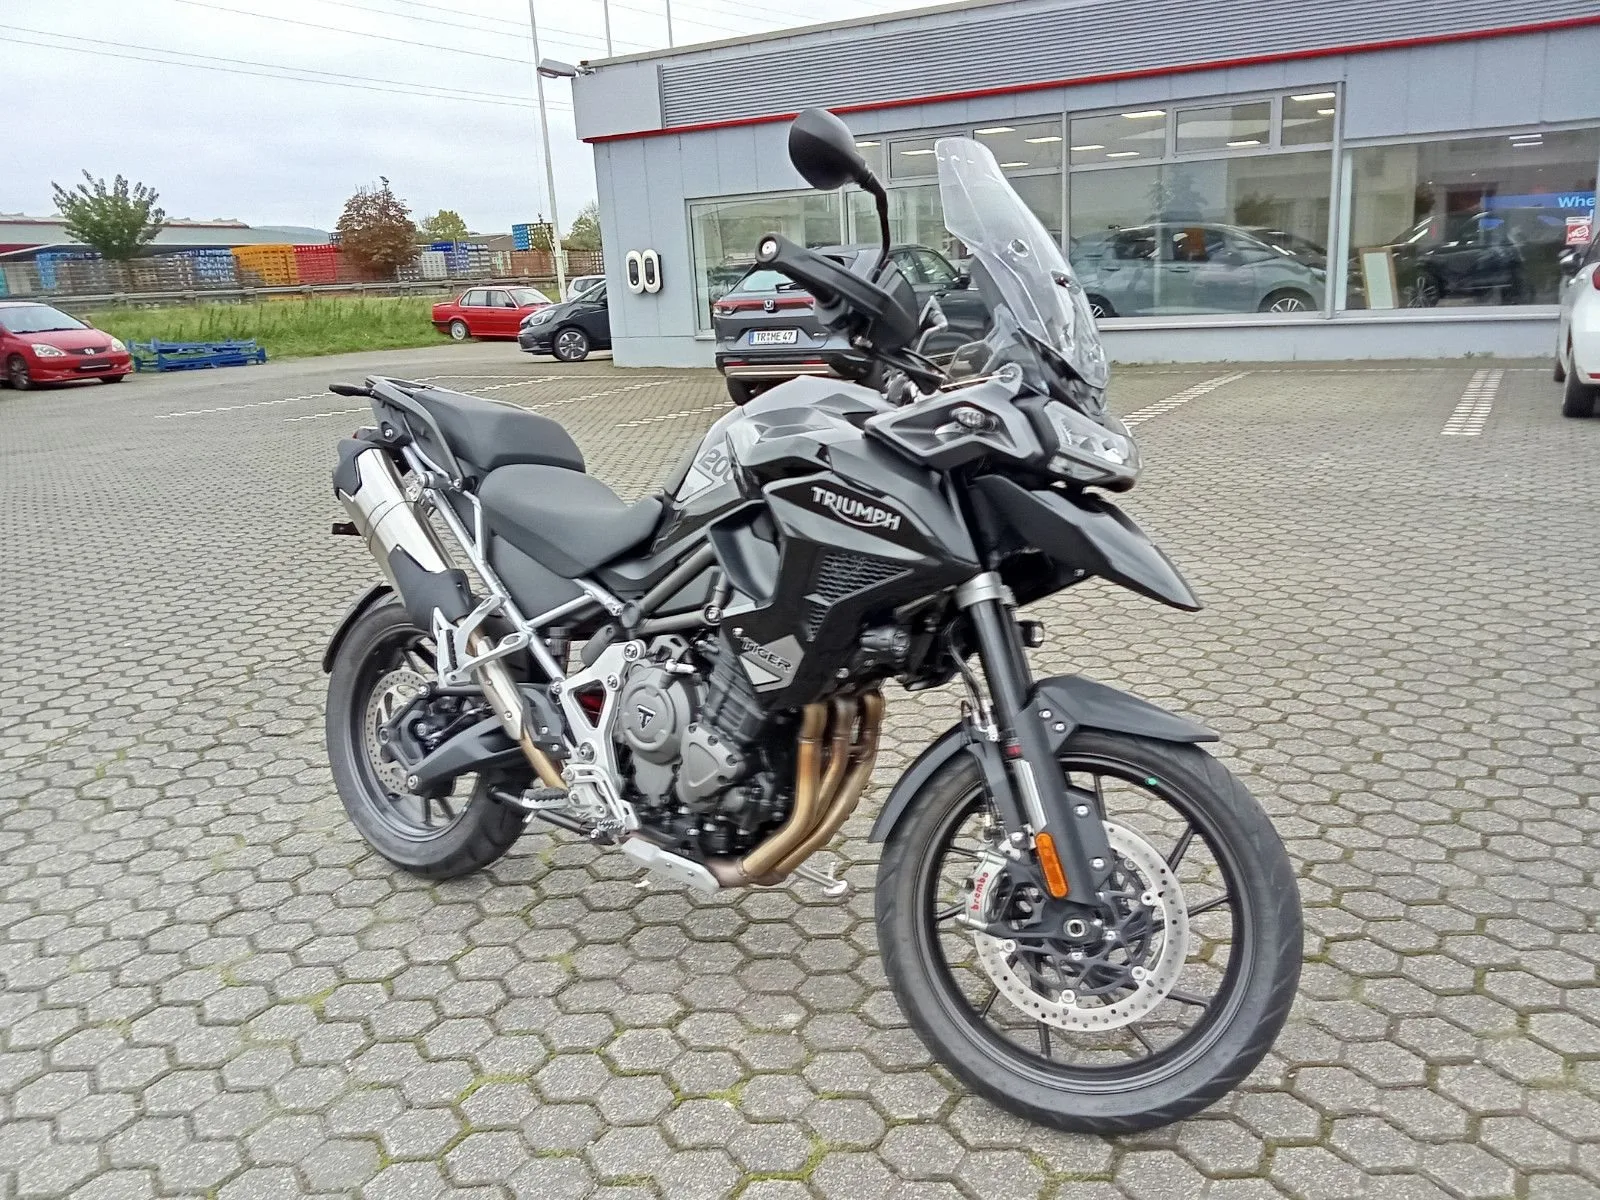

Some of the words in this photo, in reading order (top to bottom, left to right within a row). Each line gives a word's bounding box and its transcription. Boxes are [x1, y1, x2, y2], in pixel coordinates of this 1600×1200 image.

[783, 331, 793, 340] 47
[811, 486, 901, 531] TRIUMPH
[741, 636, 792, 673] TIGER
[971, 872, 989, 910] brembo
